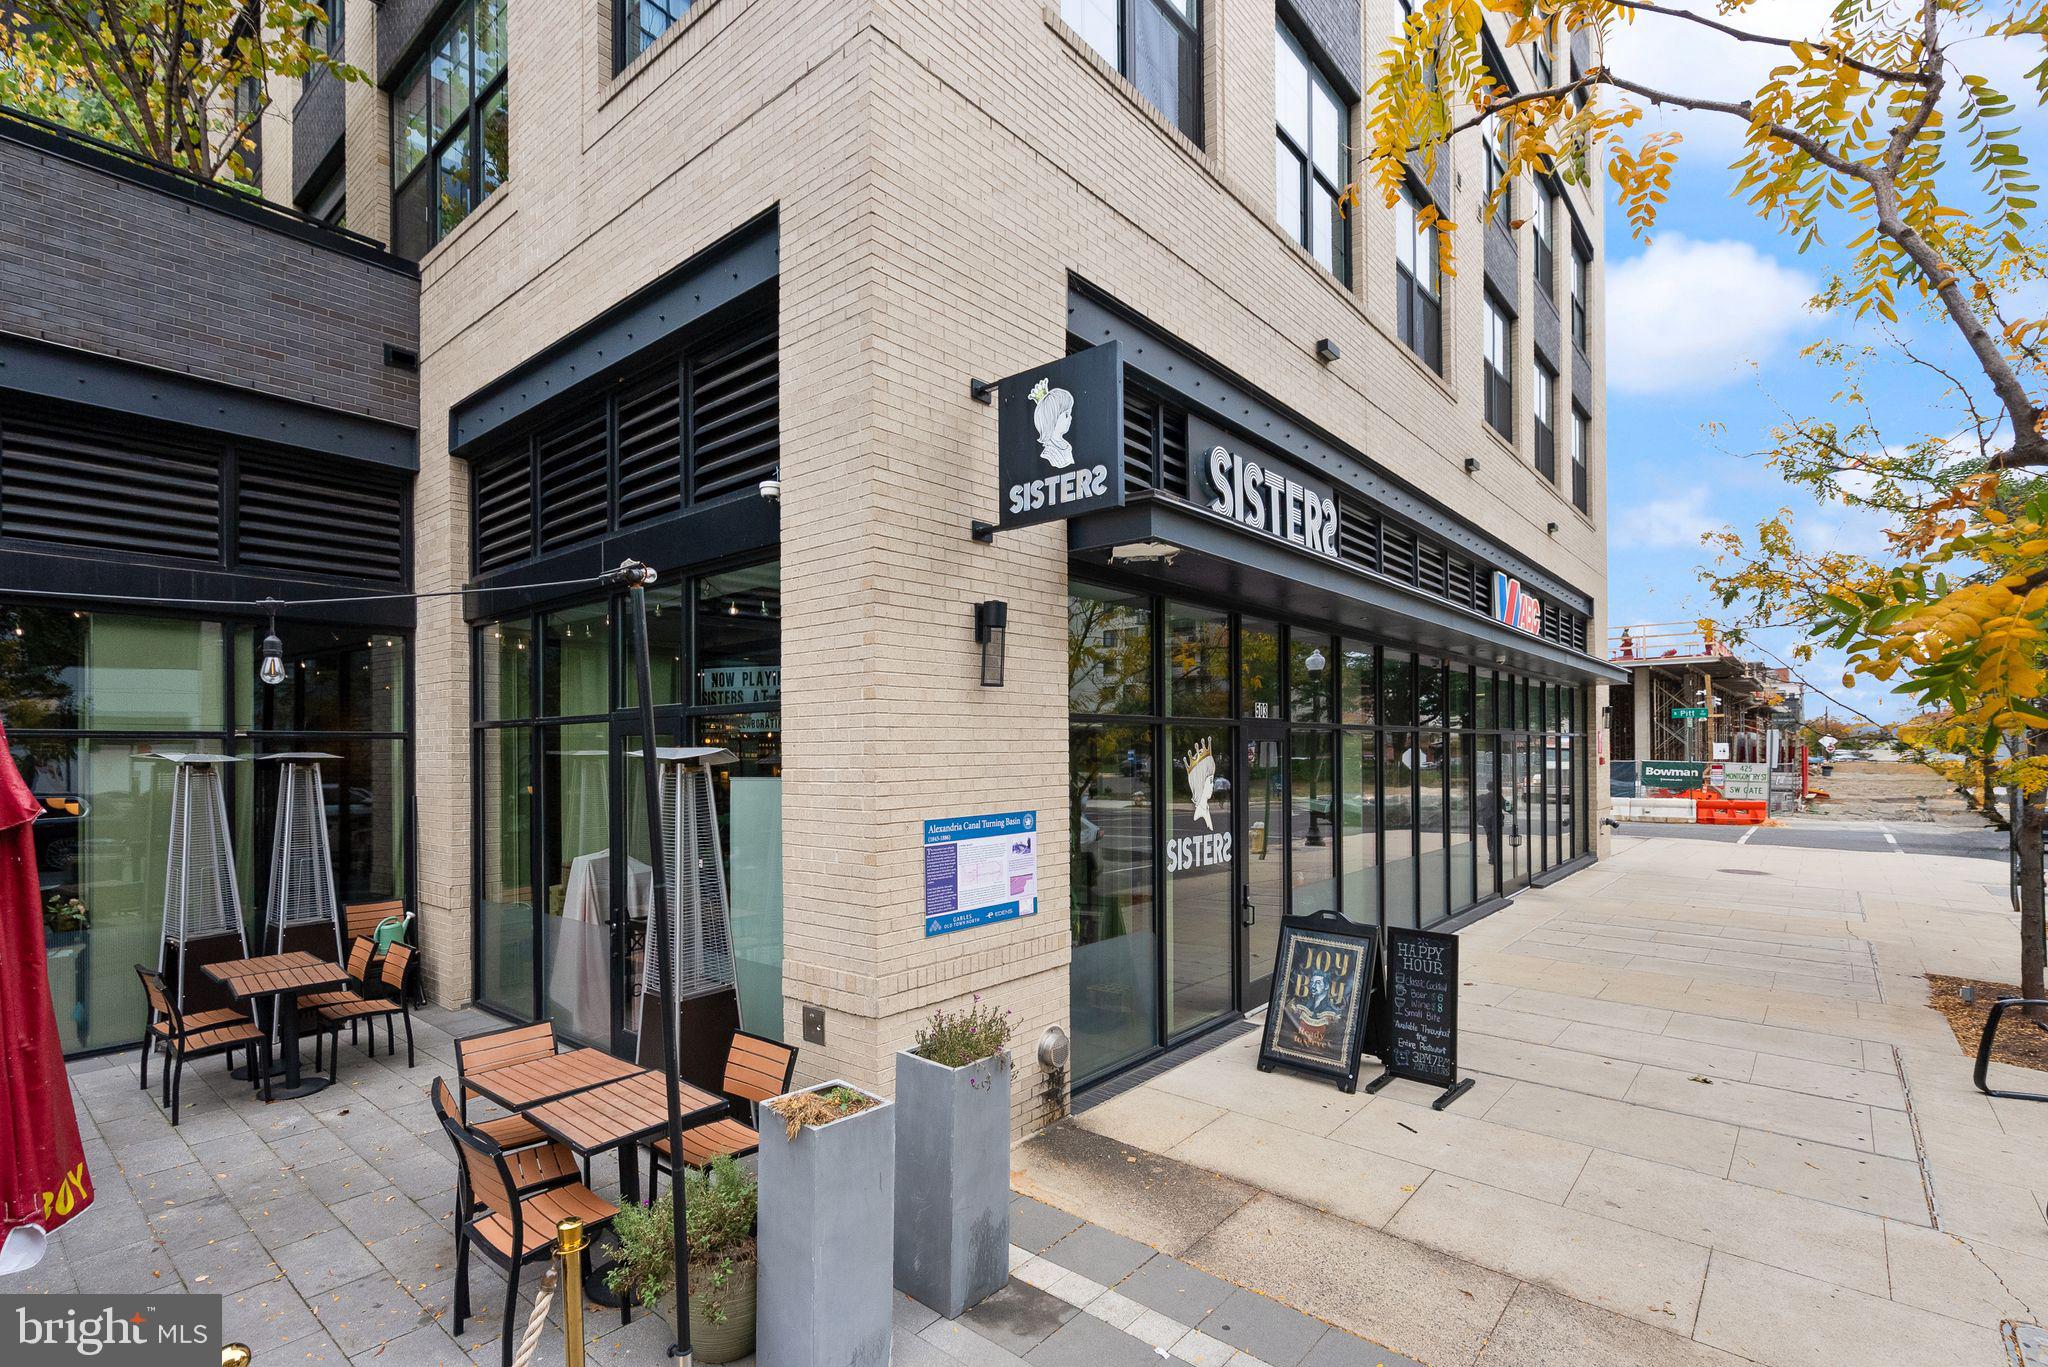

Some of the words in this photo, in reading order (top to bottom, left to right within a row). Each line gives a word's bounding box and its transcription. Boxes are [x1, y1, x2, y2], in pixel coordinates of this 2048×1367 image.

[1008, 464, 1108, 514] SISTERS
[1209, 446, 1338, 557] SISTERS
[712, 672, 735, 687] NOW
[742, 671, 781, 686] PLAYI
[702, 689, 744, 705] SISTERS
[1255, 702, 1268, 718] 503
[1645, 766, 1699, 777] Bowman
[928, 822, 962, 834] Alexandria
[963, 820, 981, 830] Canal
[982, 819, 1005, 829] Turning
[1005, 817, 1021, 826] Basin
[1166, 831, 1232, 873] SISTERS
[953, 913, 973, 922] GABLES
[1397, 942, 1444, 961] HAPPY
[1403, 957, 1444, 975] HOUR
[1404, 1007, 1423, 1018] Small
